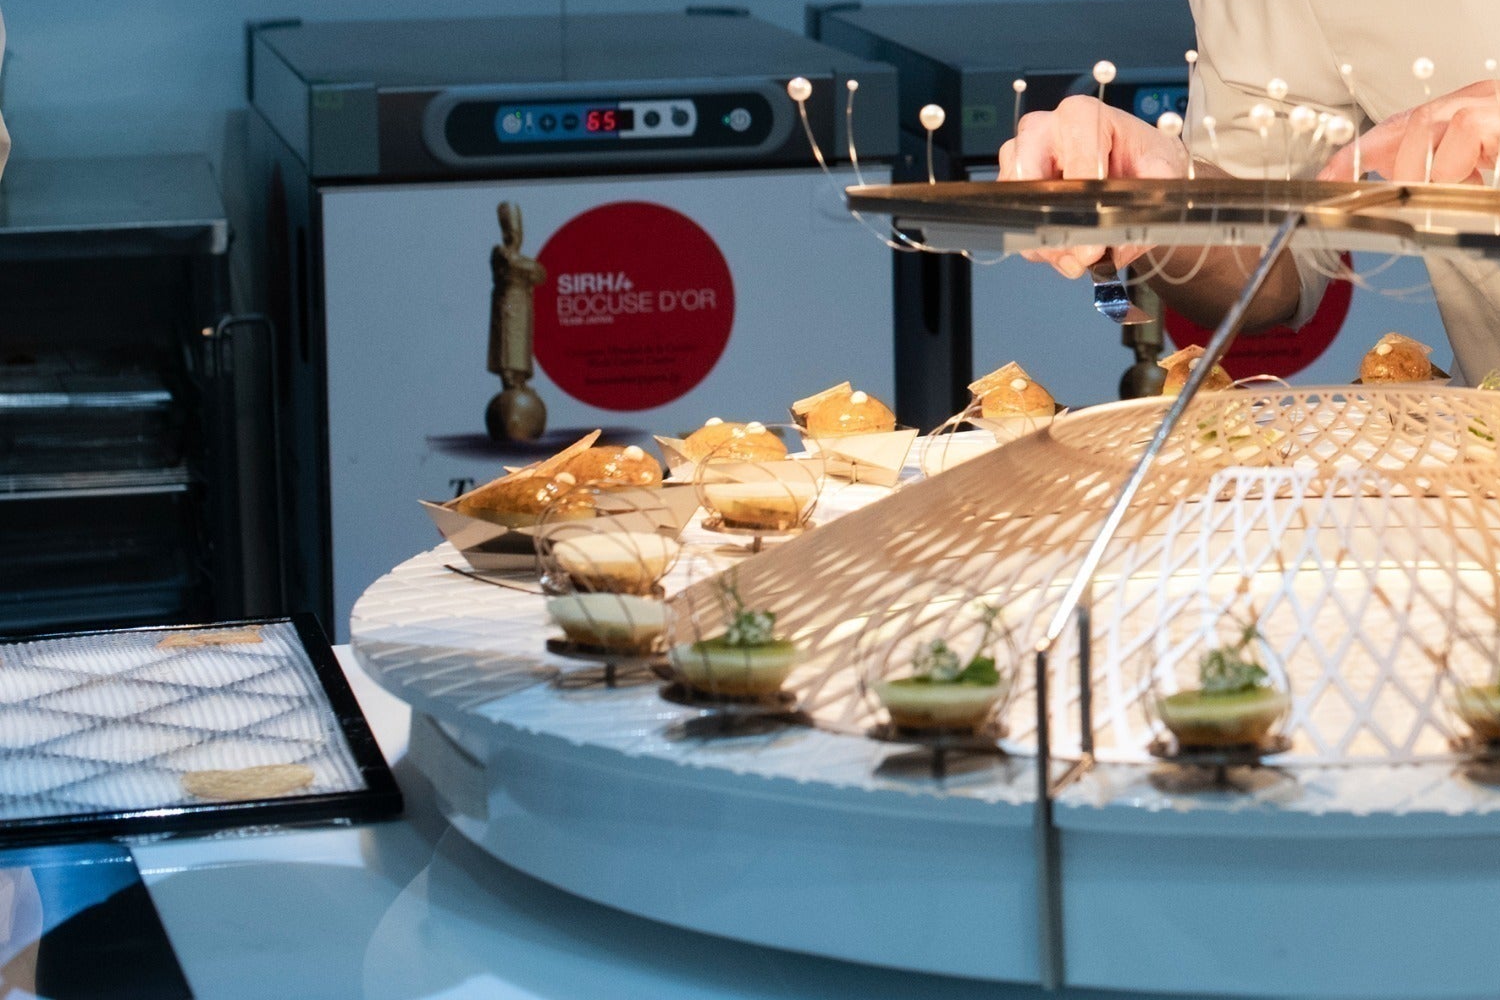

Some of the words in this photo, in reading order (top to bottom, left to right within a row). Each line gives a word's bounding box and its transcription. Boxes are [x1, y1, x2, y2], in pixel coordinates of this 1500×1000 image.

[586, 110, 616, 132] 65
[556, 290, 653, 318] BOCUSE
[658, 287, 717, 313] D'OR
